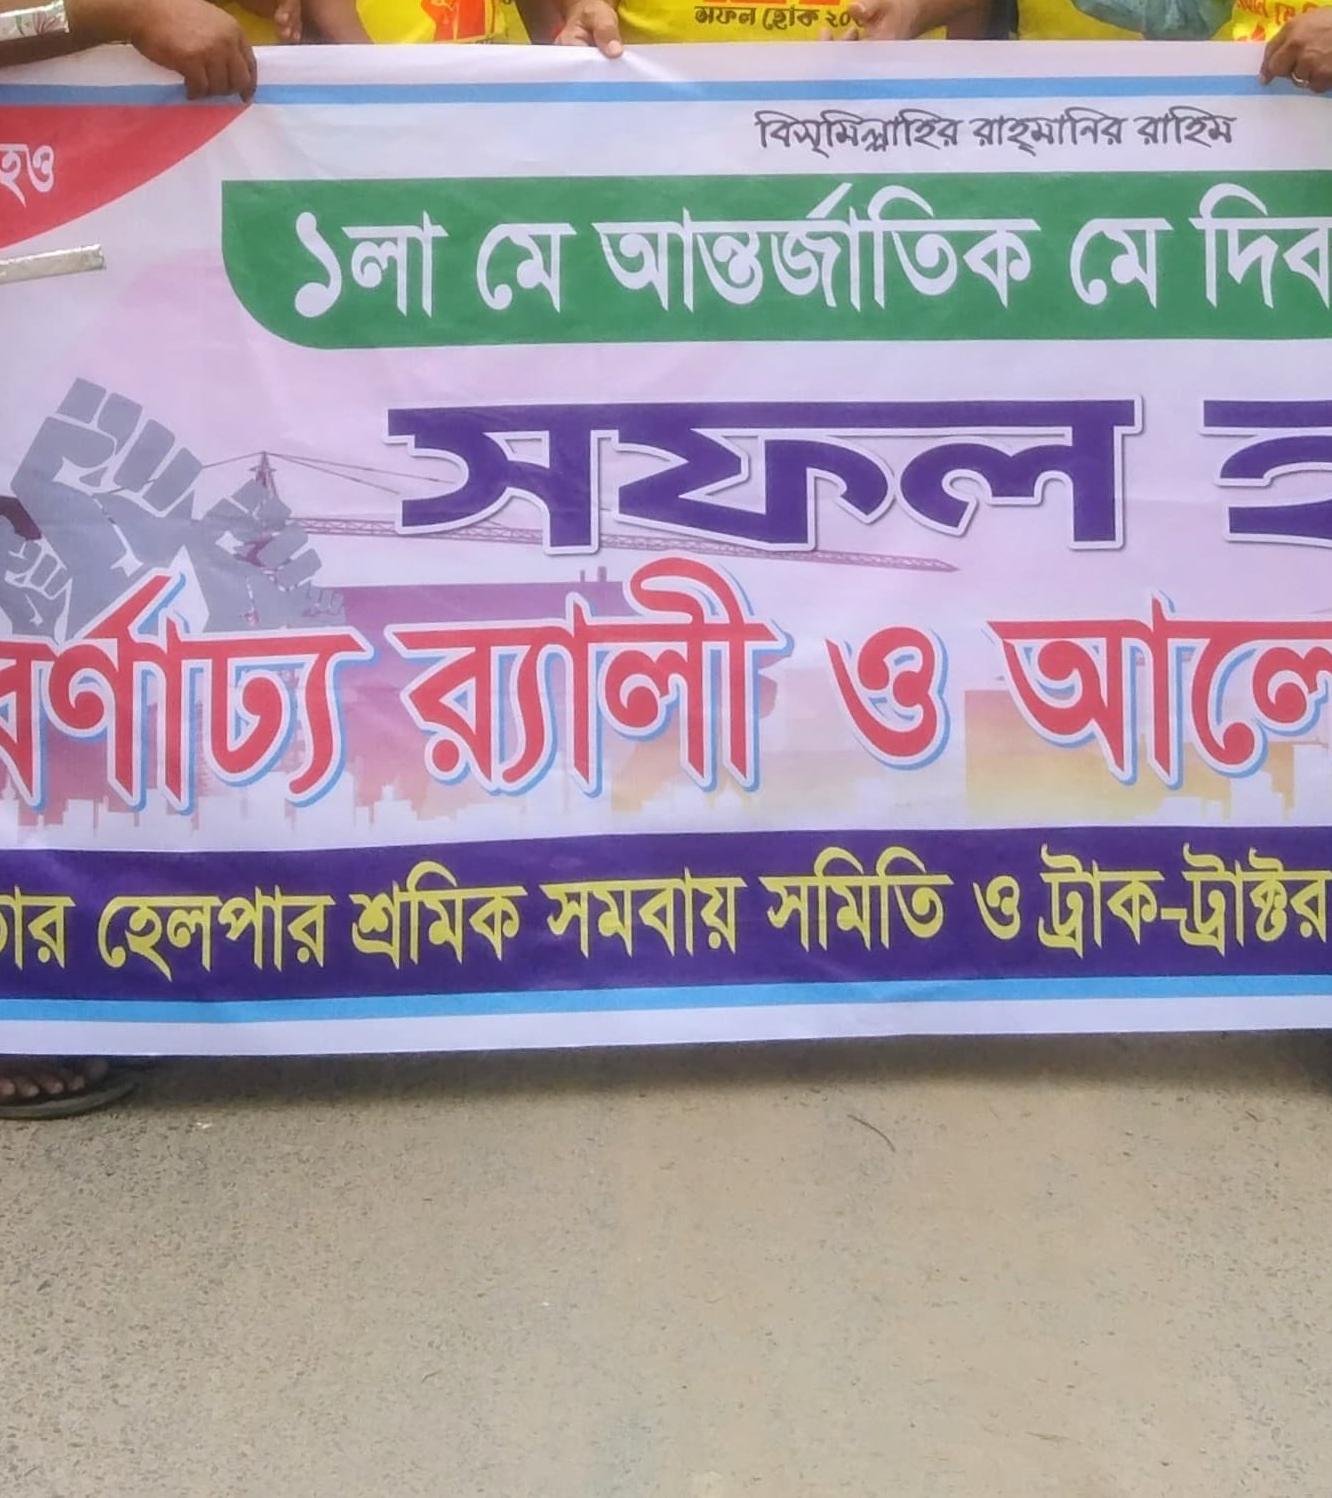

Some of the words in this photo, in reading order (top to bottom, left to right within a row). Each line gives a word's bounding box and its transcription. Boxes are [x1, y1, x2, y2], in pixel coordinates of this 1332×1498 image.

[1135, 106, 1237, 149] রাহিম
[294, 210, 449, 318] ১লা
[477, 222, 576, 313] মে
[593, 183, 1041, 313] আন্তর্জাতিক
[1069, 218, 1173, 308] মে
[387, 396, 1143, 552] সফল
[822, 620, 947, 770] ও
[97, 886, 336, 980] হেলপার
[350, 860, 528, 969] শ্রমিক
[541, 867, 747, 957] সমবায়
[759, 846, 953, 954] সমিতি
[974, 876, 1021, 939] ও
